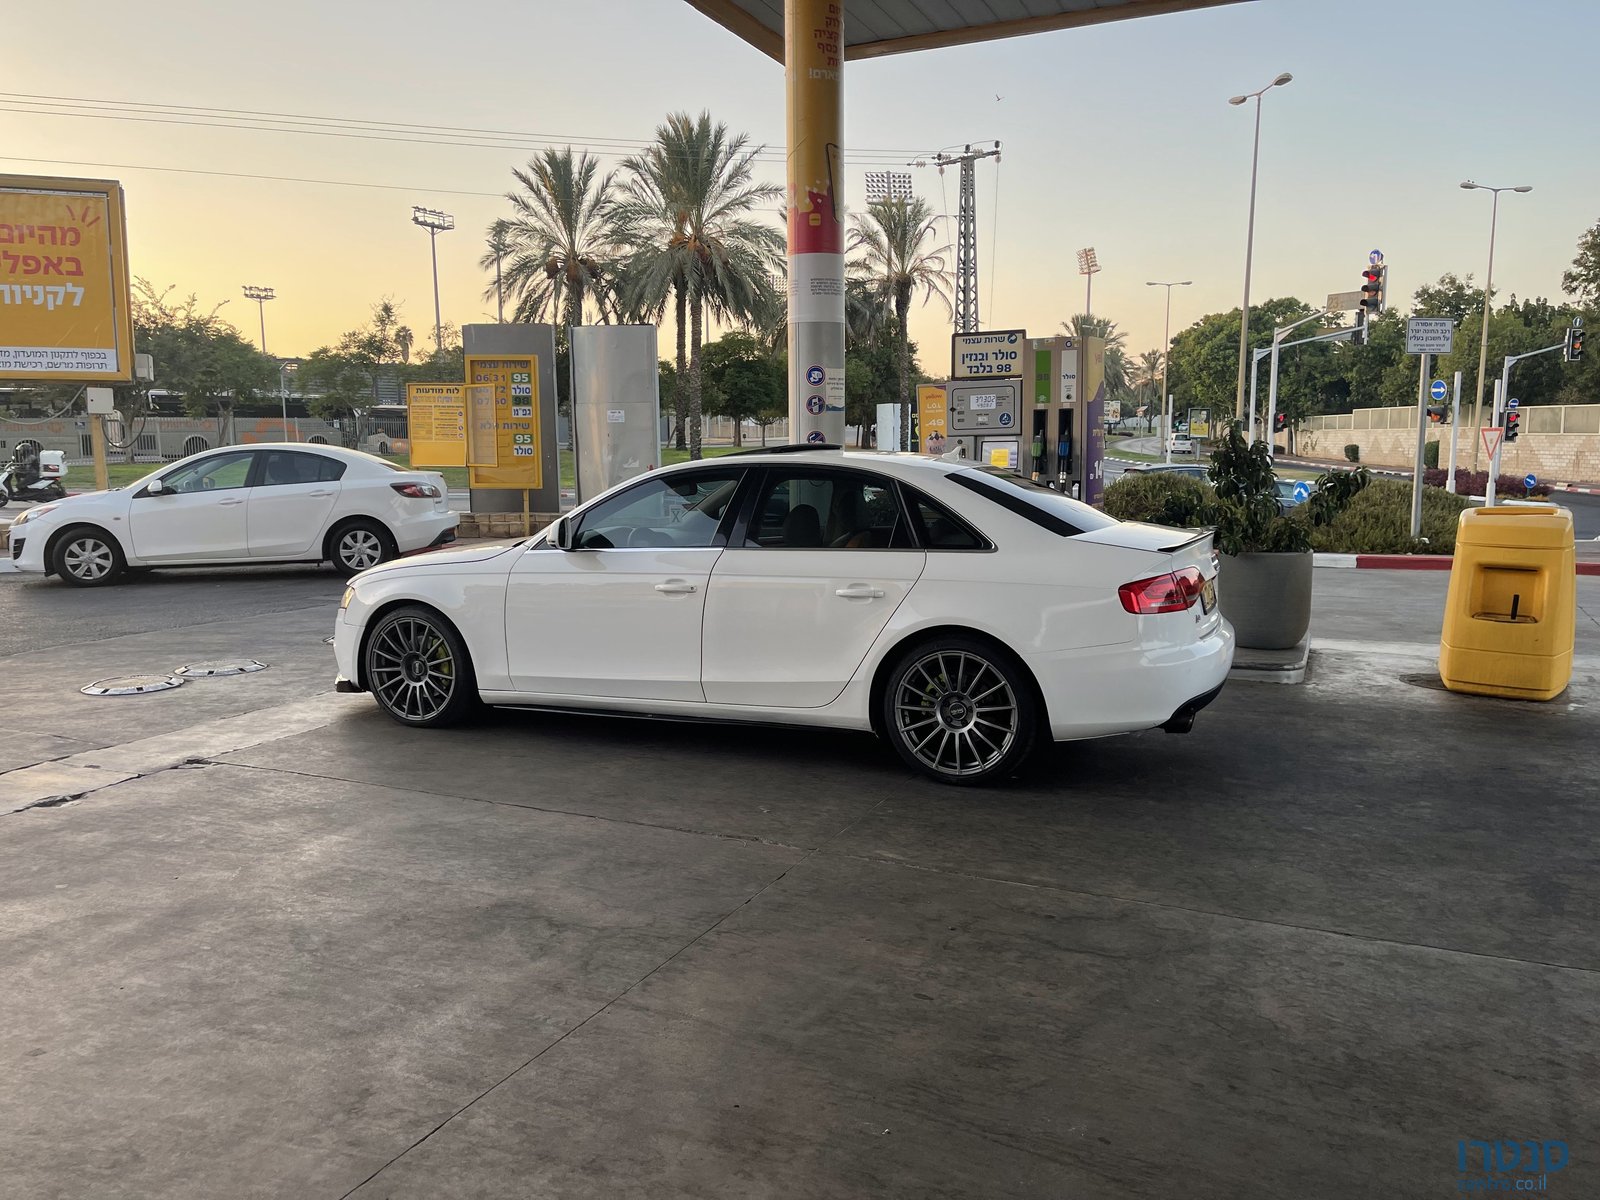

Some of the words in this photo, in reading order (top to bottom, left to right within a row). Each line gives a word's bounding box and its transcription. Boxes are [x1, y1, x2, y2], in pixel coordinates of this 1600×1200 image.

[0, 223, 81, 247] מהיום
[0, 250, 84, 276] באפל
[984, 336, 1005, 344] שרות
[50, 350, 79, 360] לתקנון
[81, 351, 107, 360] בכפוף
[961, 352, 988, 365] ובנזין
[992, 349, 1017, 360] סולר
[13, 361, 43, 369] רכישת
[75, 361, 107, 370] תרופות
[967, 362, 993, 374] בלבד
[996, 364, 1012, 373] 98
[513, 373, 529, 382] 95
[511, 385, 531, 395] סולר
[515, 434, 531, 443] 95
[514, 446, 533, 455] סולר
